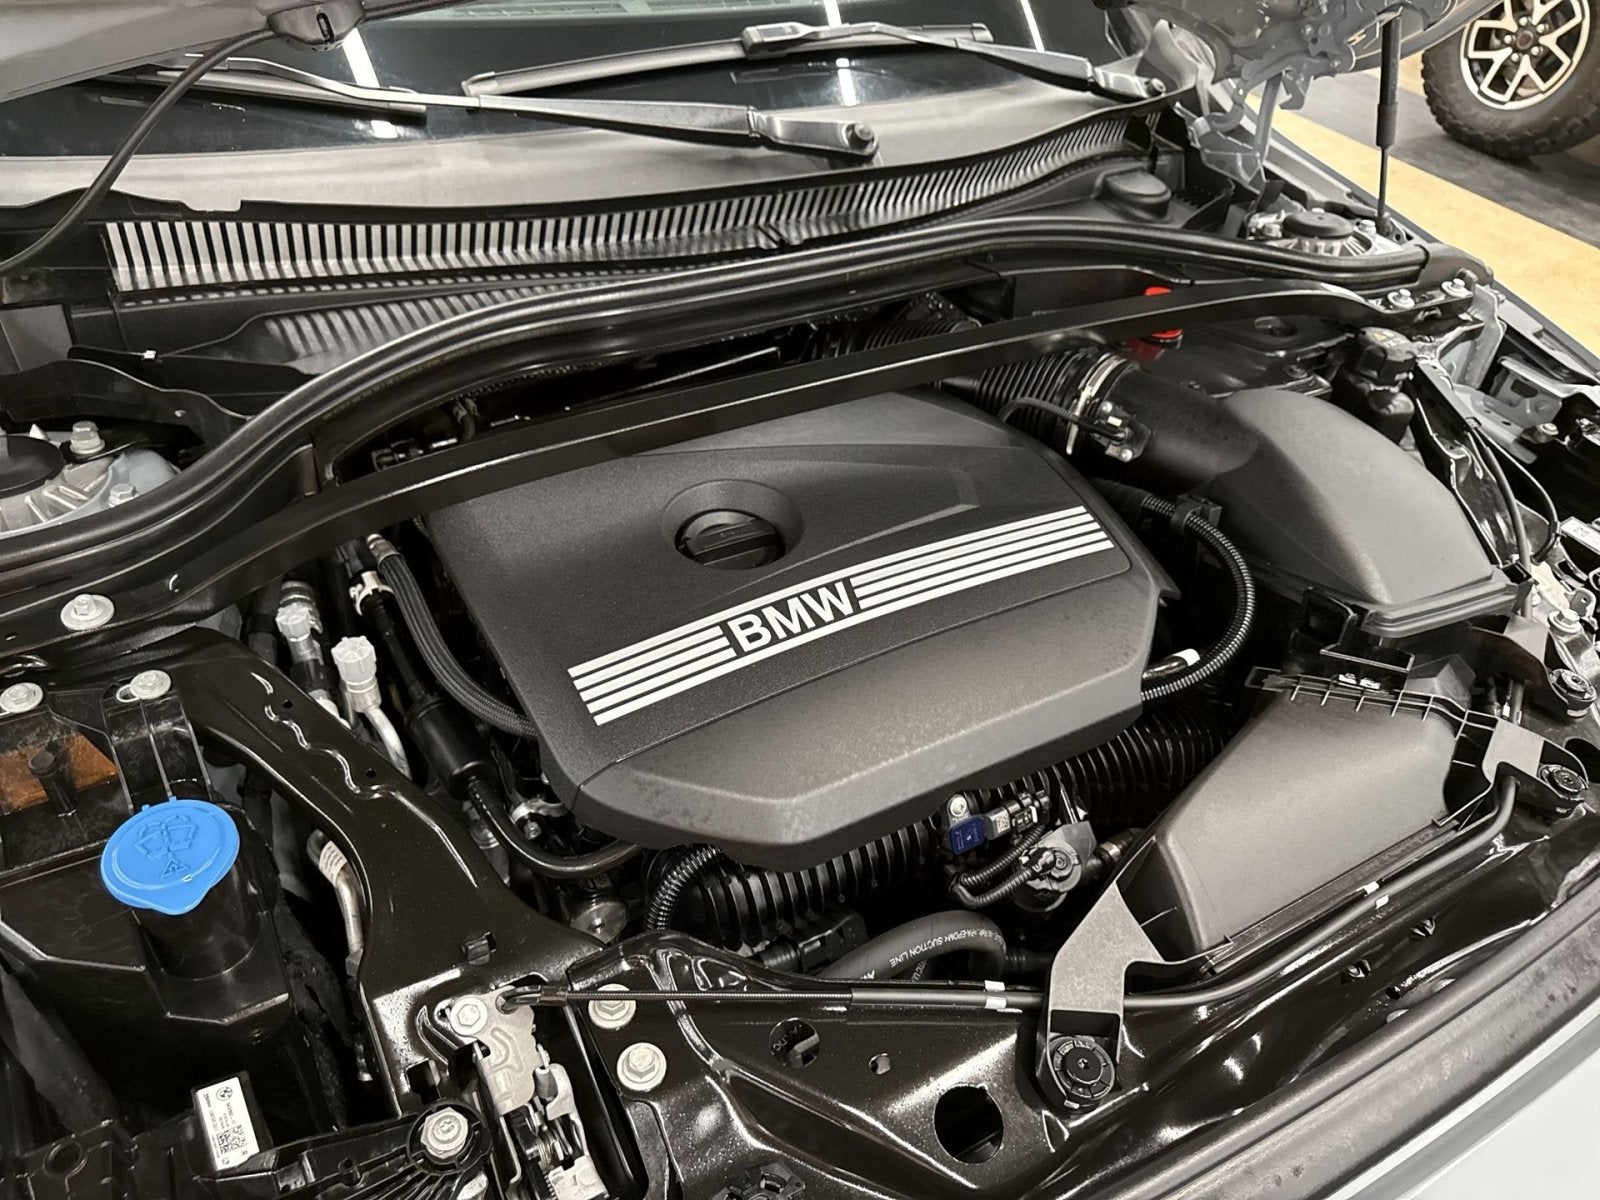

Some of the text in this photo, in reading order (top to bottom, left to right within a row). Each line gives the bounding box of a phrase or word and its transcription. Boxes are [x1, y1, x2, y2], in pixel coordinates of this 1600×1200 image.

[727, 581, 853, 653] BMW
[909, 937, 943, 957] SUCTION
[889, 954, 909, 968] LINE
